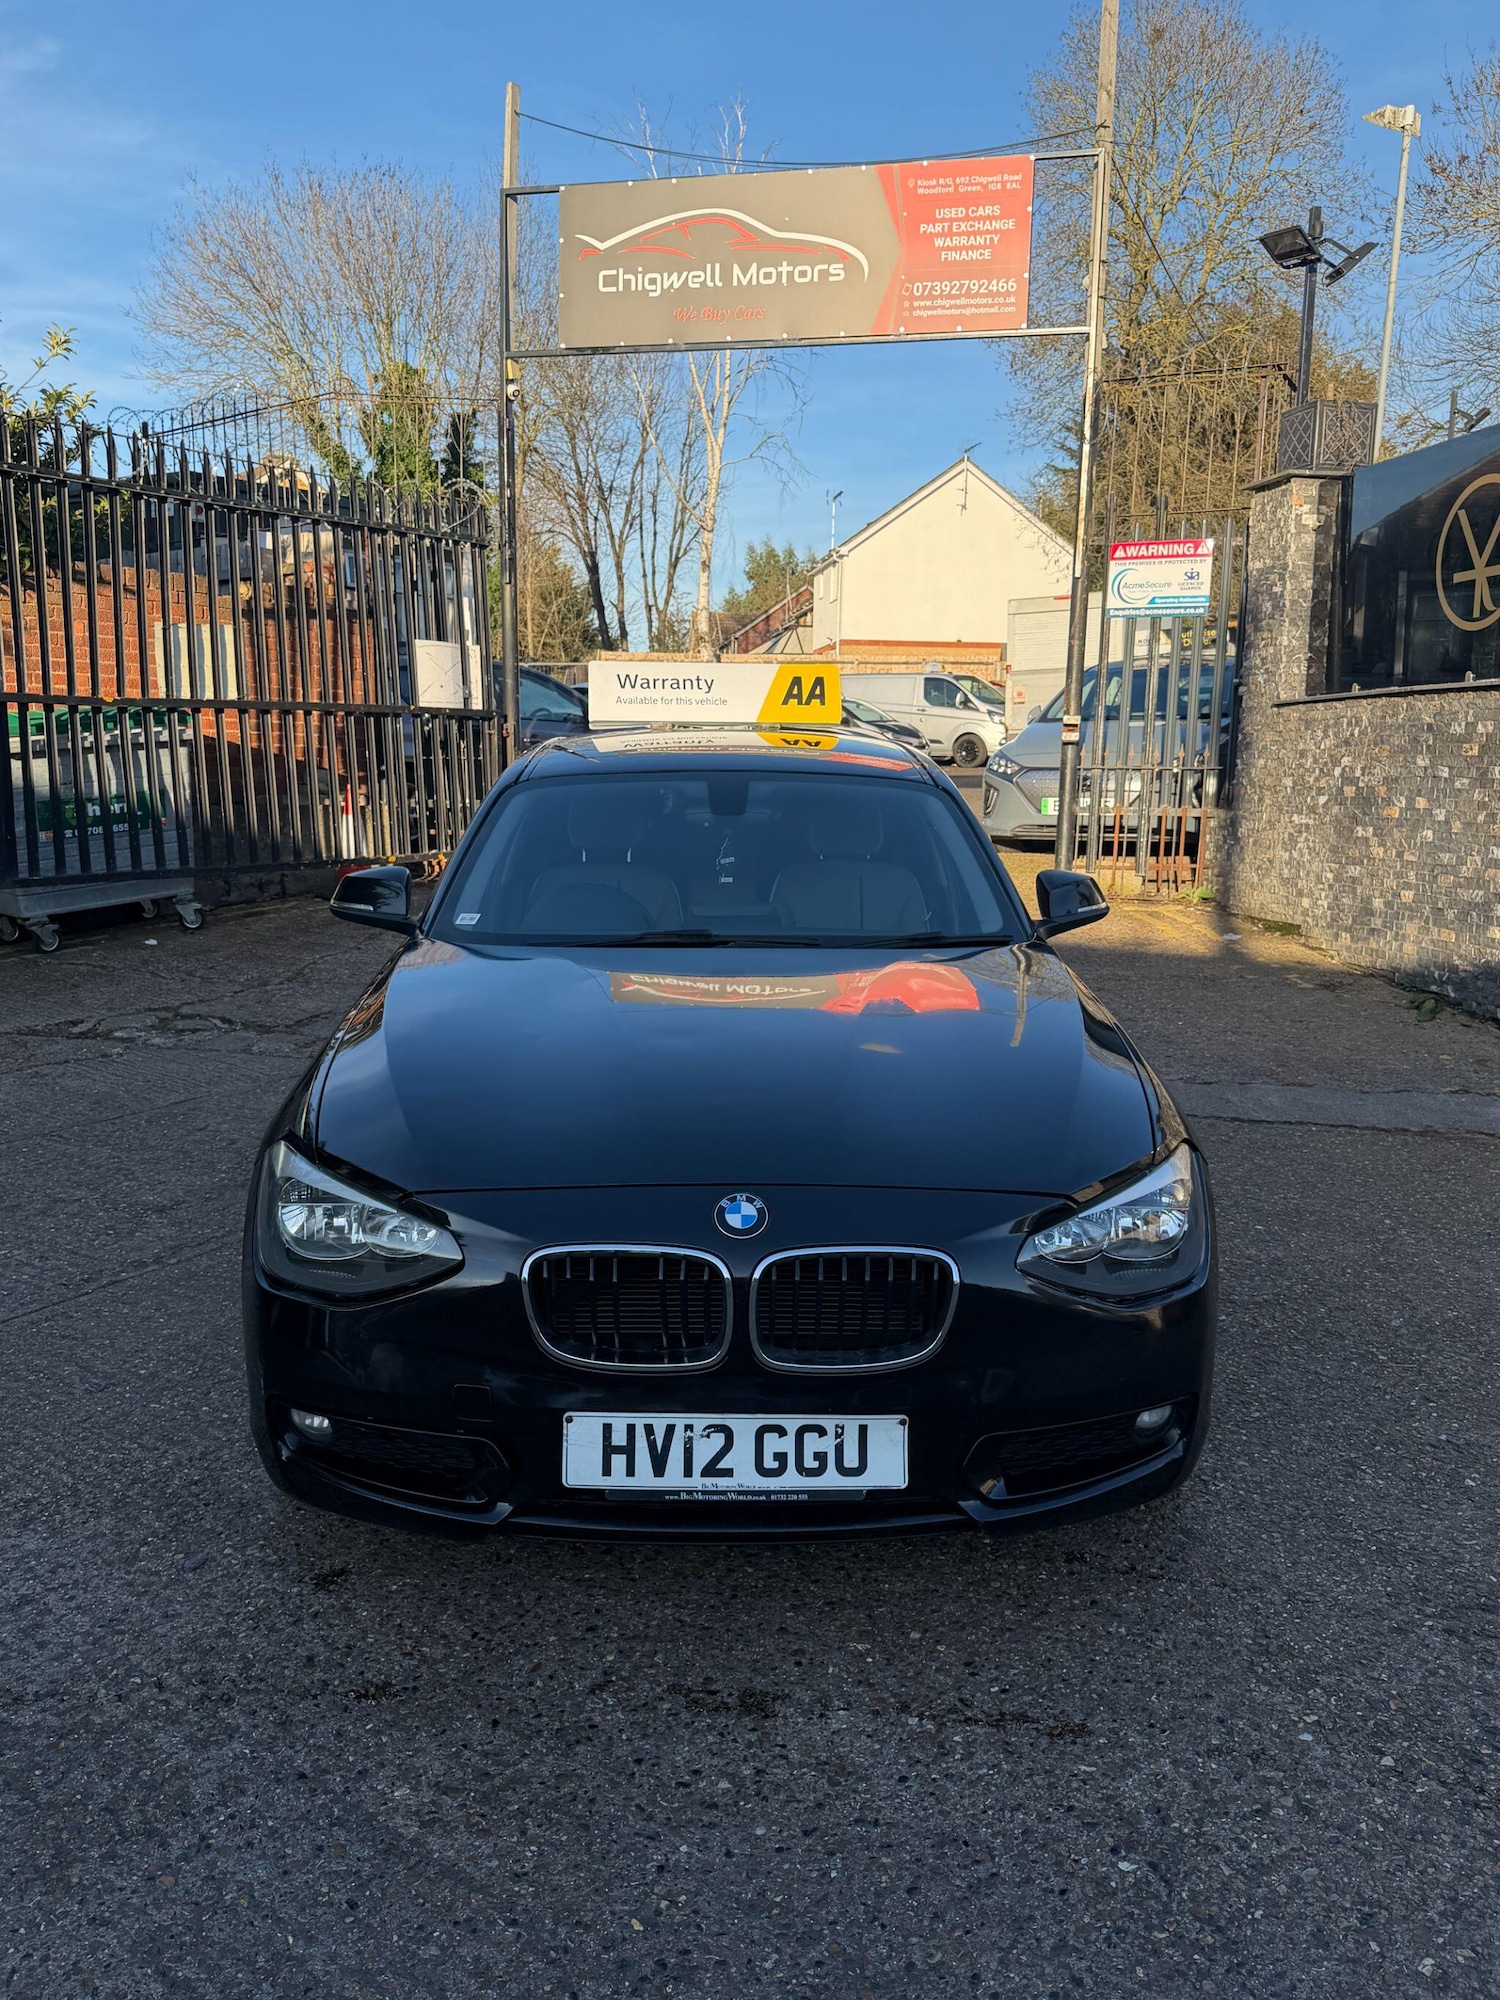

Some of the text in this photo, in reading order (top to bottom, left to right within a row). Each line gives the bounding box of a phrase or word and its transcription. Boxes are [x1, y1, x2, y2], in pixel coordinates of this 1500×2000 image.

[917, 178, 938, 187] Kiosk
[956, 176, 970, 185] 692
[971, 174, 1002, 184] Chigwell
[1003, 173, 1022, 182] Road
[917, 184, 954, 195] Woodford
[935, 205, 1001, 219] USED CARS
[920, 219, 1016, 235] PART EXCHANGE
[934, 234, 1000, 248] WARRANTY
[941, 249, 992, 262] FINANCE
[598, 260, 845, 297] Chigwell Motors
[913, 278, 1017, 296] 07392792466
[912, 296, 1016, 308] www.chigwellmotors.co.uk
[673, 304, 766, 325] We Buy Cars
[912, 305, 1016, 317] chigwellmotors@hotmail.com
[1125, 543, 1195, 557] WARNING
[1121, 581, 1172, 590] AcmeSecure
[617, 673, 715, 694] Warranty
[781, 676, 826, 706] AA
[616, 696, 728, 706] Available for this vehicle
[720, 1194, 763, 1209] BMW
[602, 1423, 869, 1478] HV12 GGU
